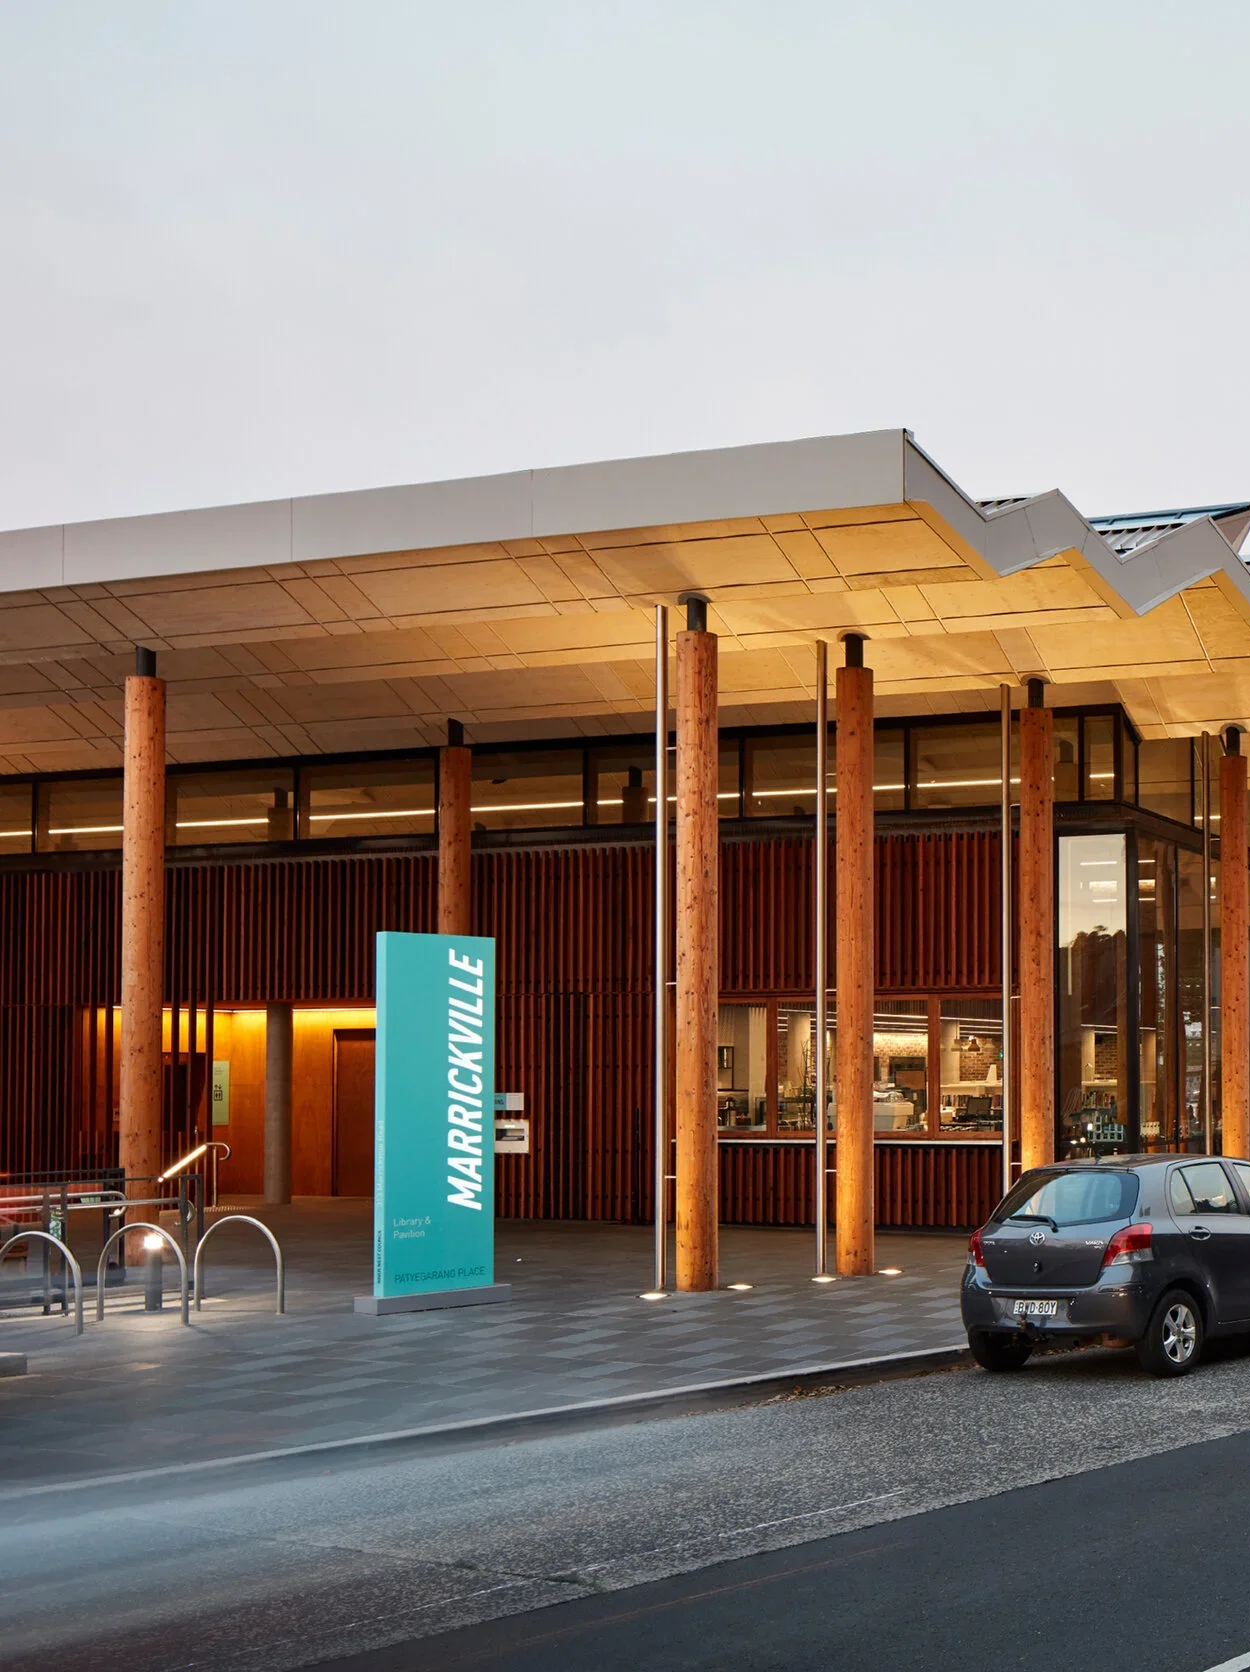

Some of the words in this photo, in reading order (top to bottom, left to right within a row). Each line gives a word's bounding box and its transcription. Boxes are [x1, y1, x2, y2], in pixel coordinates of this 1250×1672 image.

[447, 948, 484, 1210] MARRICKVILLE
[393, 1218, 423, 1227] Library
[424, 1216, 431, 1225] &
[393, 1230, 426, 1239] Pavilion
[394, 1268, 456, 1284] PATYEGARANG
[458, 1266, 485, 1277] PLACE
